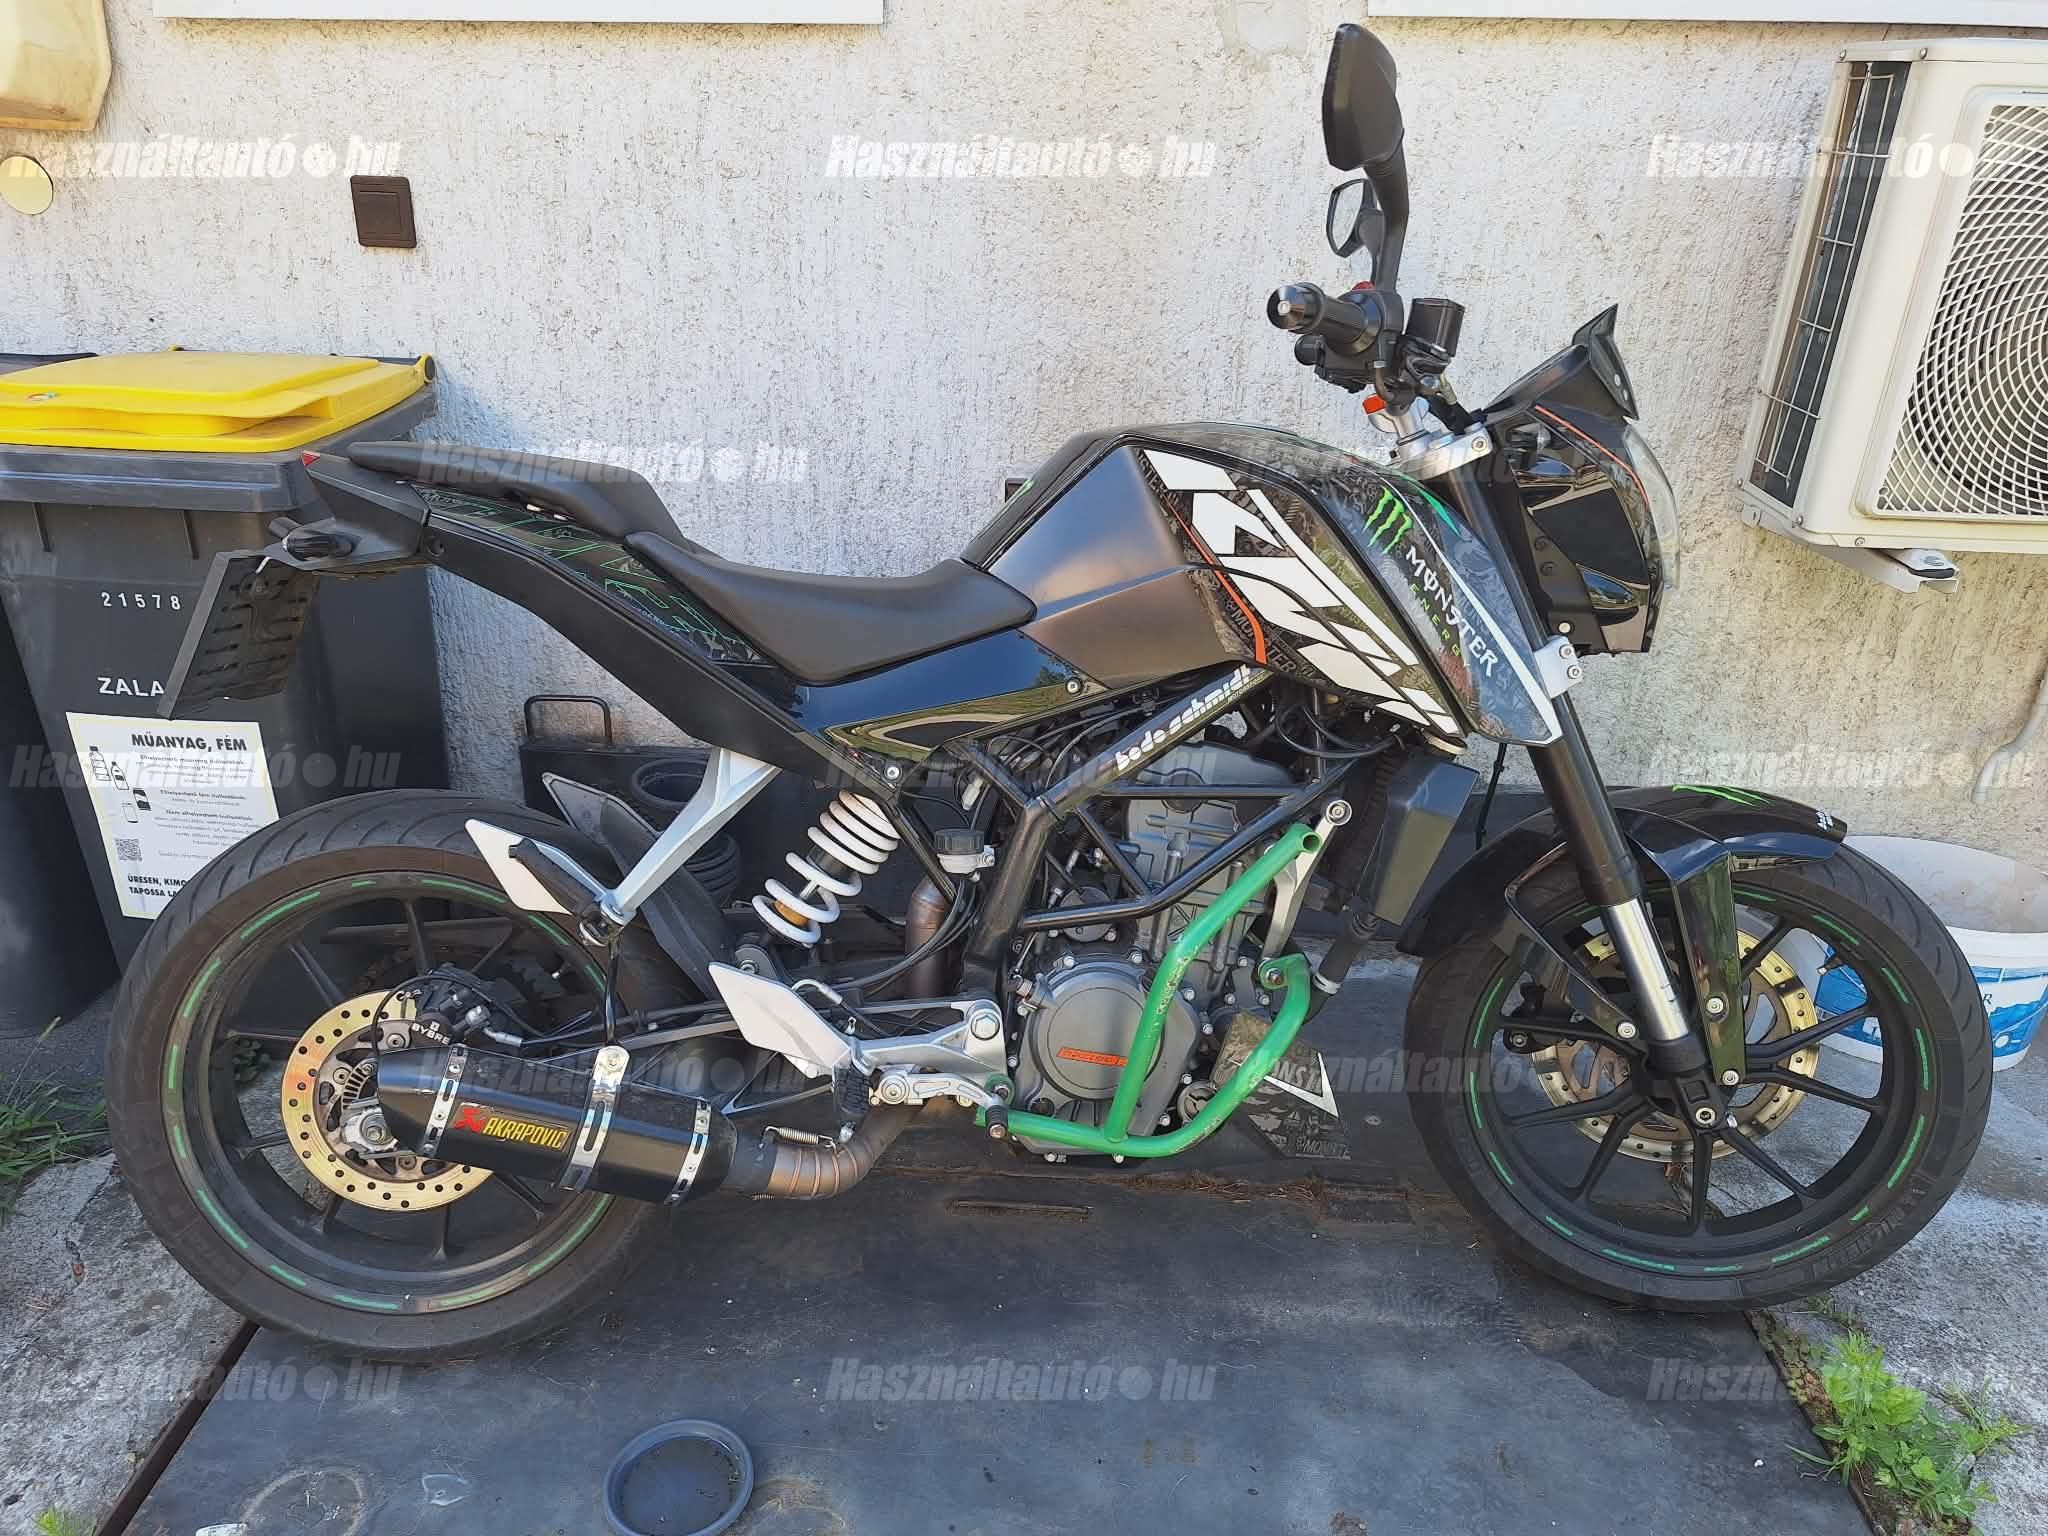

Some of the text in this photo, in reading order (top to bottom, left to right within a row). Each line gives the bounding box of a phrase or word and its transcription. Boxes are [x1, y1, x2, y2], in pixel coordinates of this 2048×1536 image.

[100, 591, 181, 610] 21578
[1405, 545, 1499, 677] MONSTER
[97, 676, 165, 697] ZALA
[215, 734, 248, 751] FÉM
[129, 886, 165, 897] TAPOSSA
[411, 1022, 450, 1046] BYBRE
